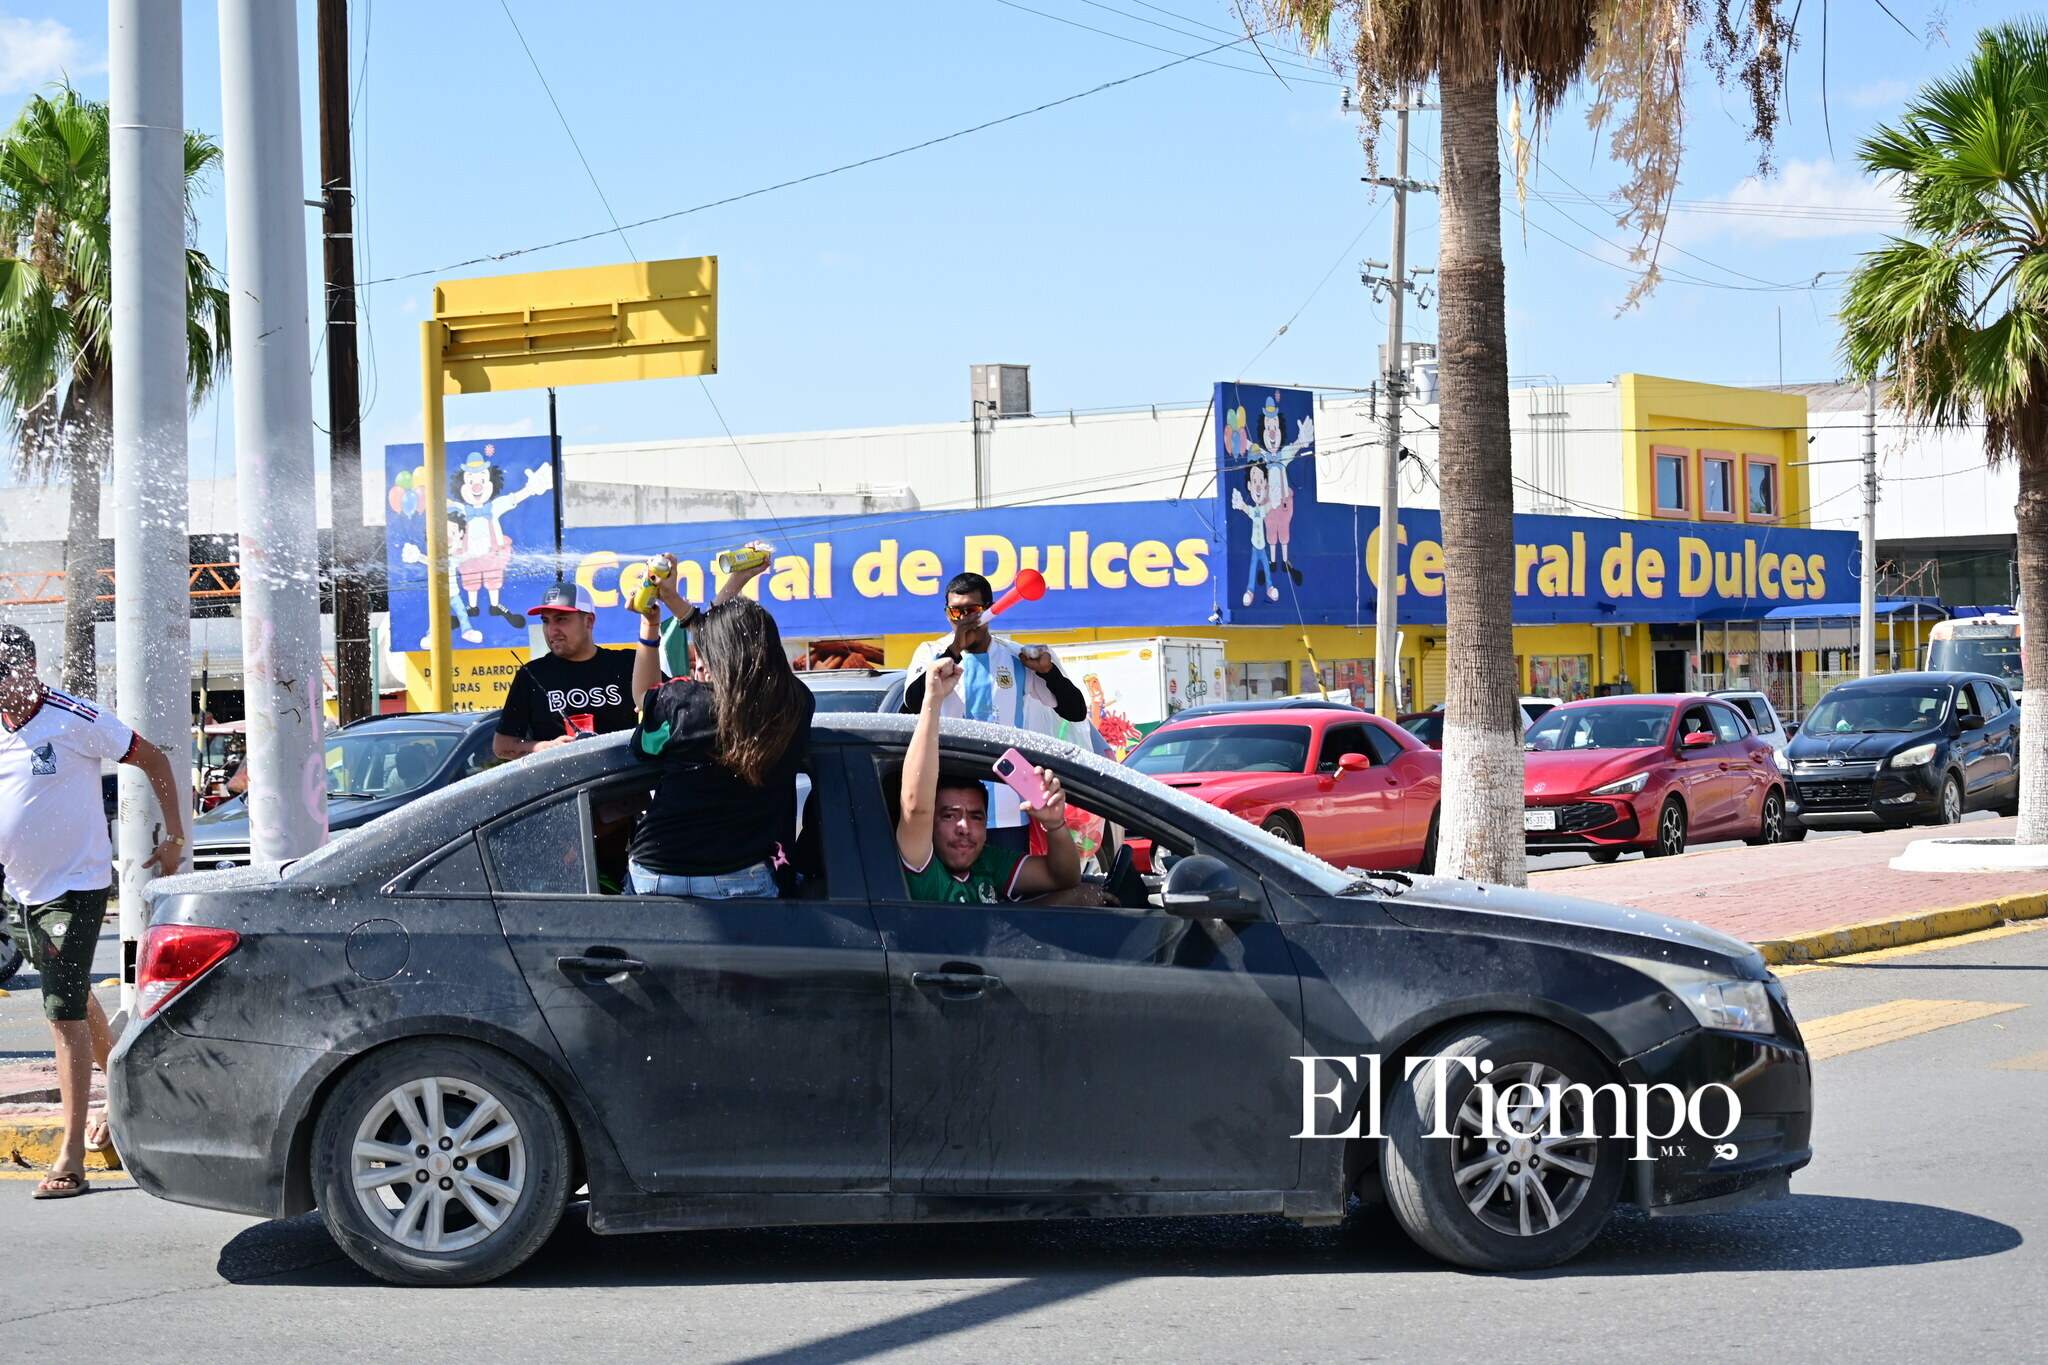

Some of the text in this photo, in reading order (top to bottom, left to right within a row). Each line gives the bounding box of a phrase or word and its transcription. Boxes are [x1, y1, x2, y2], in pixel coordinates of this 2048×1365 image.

[852, 538, 943, 599] de
[964, 531, 1210, 592] Dulces
[1365, 523, 1826, 599] Ceral de Dulces
[471, 665, 521, 676] ABARROT
[452, 683, 480, 692] URAS
[548, 684, 622, 712] BOSS
